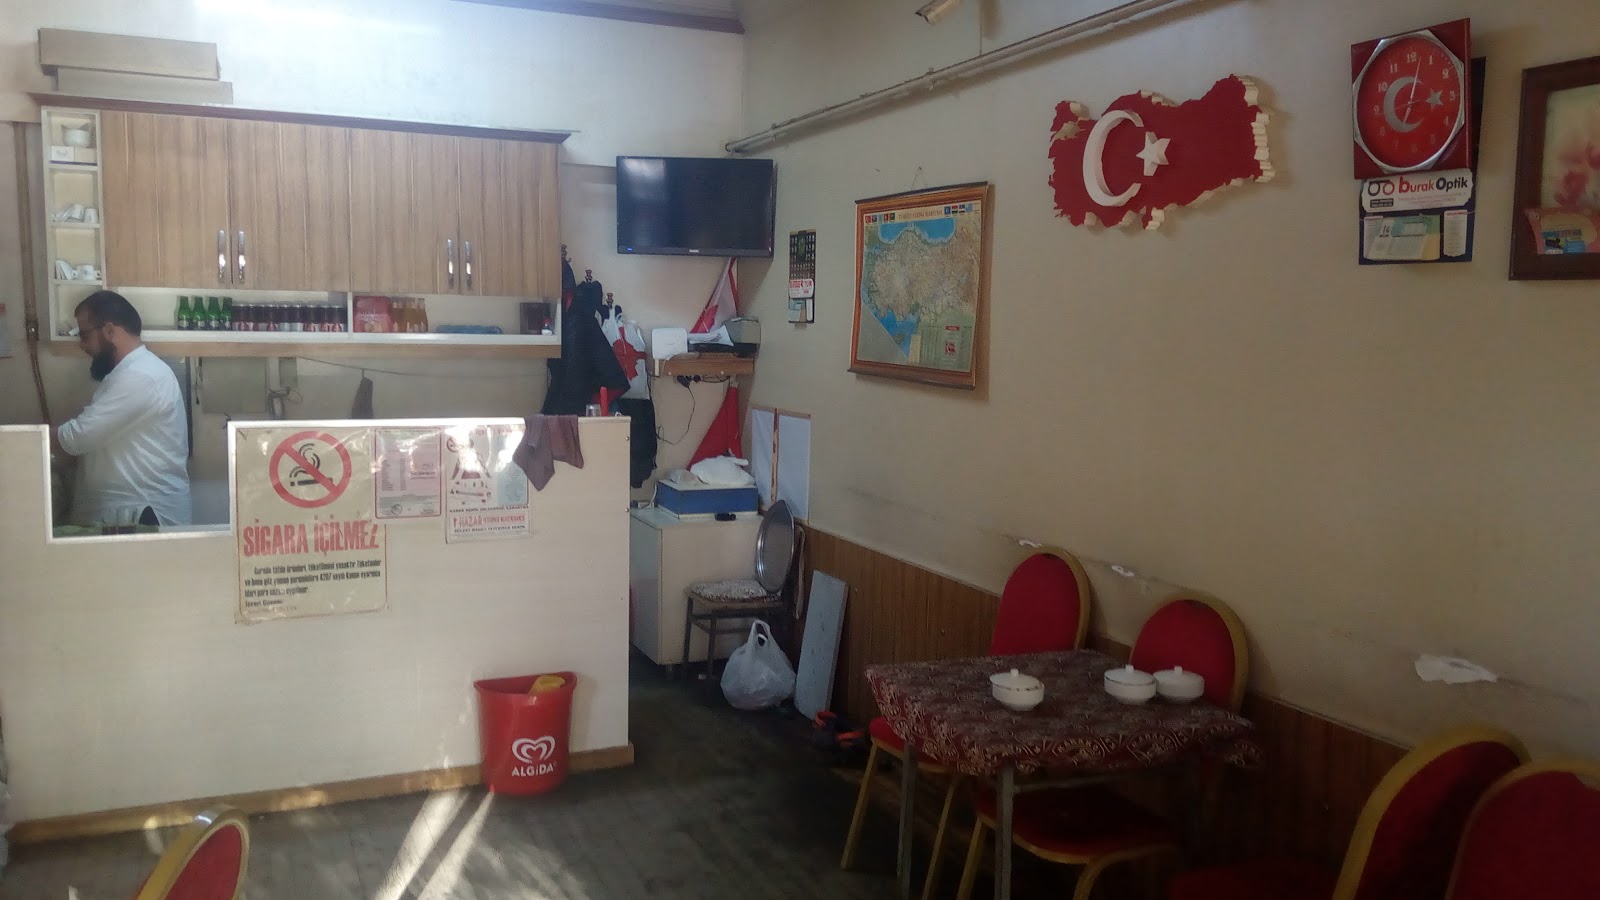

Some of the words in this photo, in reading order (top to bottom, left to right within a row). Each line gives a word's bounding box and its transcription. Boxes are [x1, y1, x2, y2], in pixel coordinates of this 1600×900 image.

[1406, 52, 1417, 63] 12
[1429, 55, 1433, 65] 1
[1389, 63, 1398, 73] 11
[1442, 68, 1449, 79] 2
[1378, 82, 1388, 92] 10
[1449, 90, 1456, 101] 3
[1373, 105, 1379, 115] 9
[1398, 176, 1434, 194] burak
[1436, 177, 1468, 192] Optik
[243, 518, 309, 557] SİGARA
[314, 514, 379, 556] İÇİLMEZ
